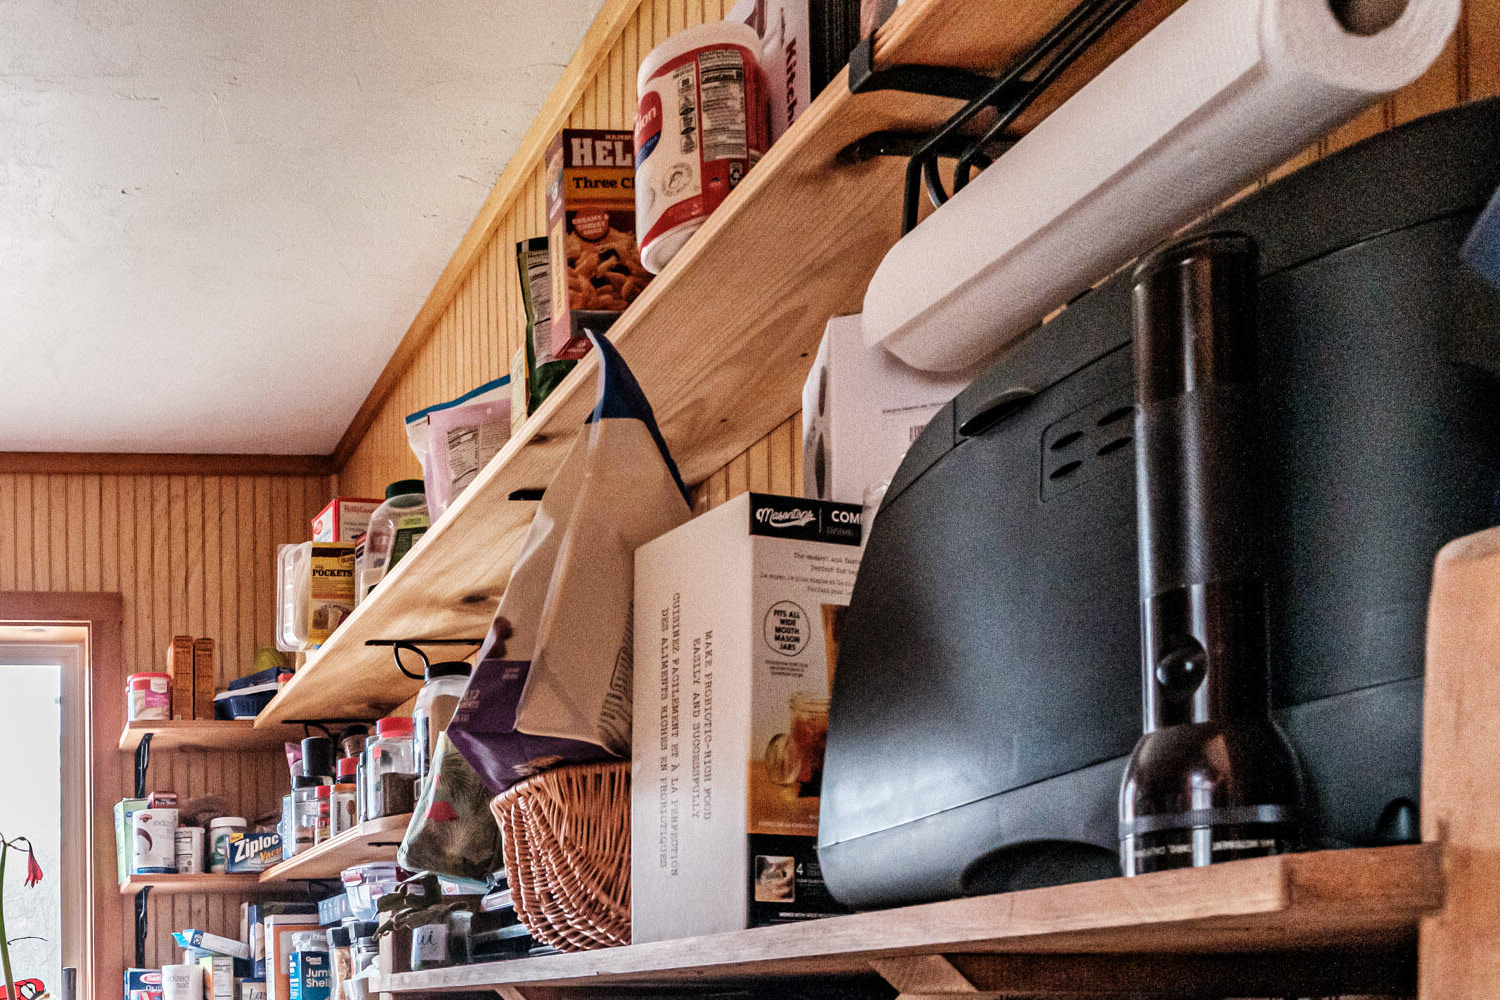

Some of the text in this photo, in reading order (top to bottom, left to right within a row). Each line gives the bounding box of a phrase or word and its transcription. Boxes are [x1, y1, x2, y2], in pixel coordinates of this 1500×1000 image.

[570, 137, 634, 167] HEL
[572, 176, 617, 189] Three
[311, 568, 354, 578] POCKETS
[671, 592, 681, 652] CUISINEZ
[779, 618, 797, 627] WIDE
[788, 610, 801, 619] ALL
[774, 634, 800, 643] MASON
[775, 626, 800, 634] MOUTH
[779, 642, 796, 651] JARS
[670, 658, 680, 738] FACILEMENT
[691, 637, 701, 818] EASILY AND SUCCESSFULLY
[702, 629, 713, 820] MAKE PROBIOTIC-RICH FOOD
[659, 607, 669, 868] DES ALIMENTS RICHES EN PROBIOTIQUES
[670, 742, 679, 758] ET
[670, 777, 679, 794] LA
[670, 799, 679, 877] PERFECTION
[234, 834, 280, 863] Ziploc
[259, 846, 283, 863] Vacu
[796, 863, 804, 876] 4
